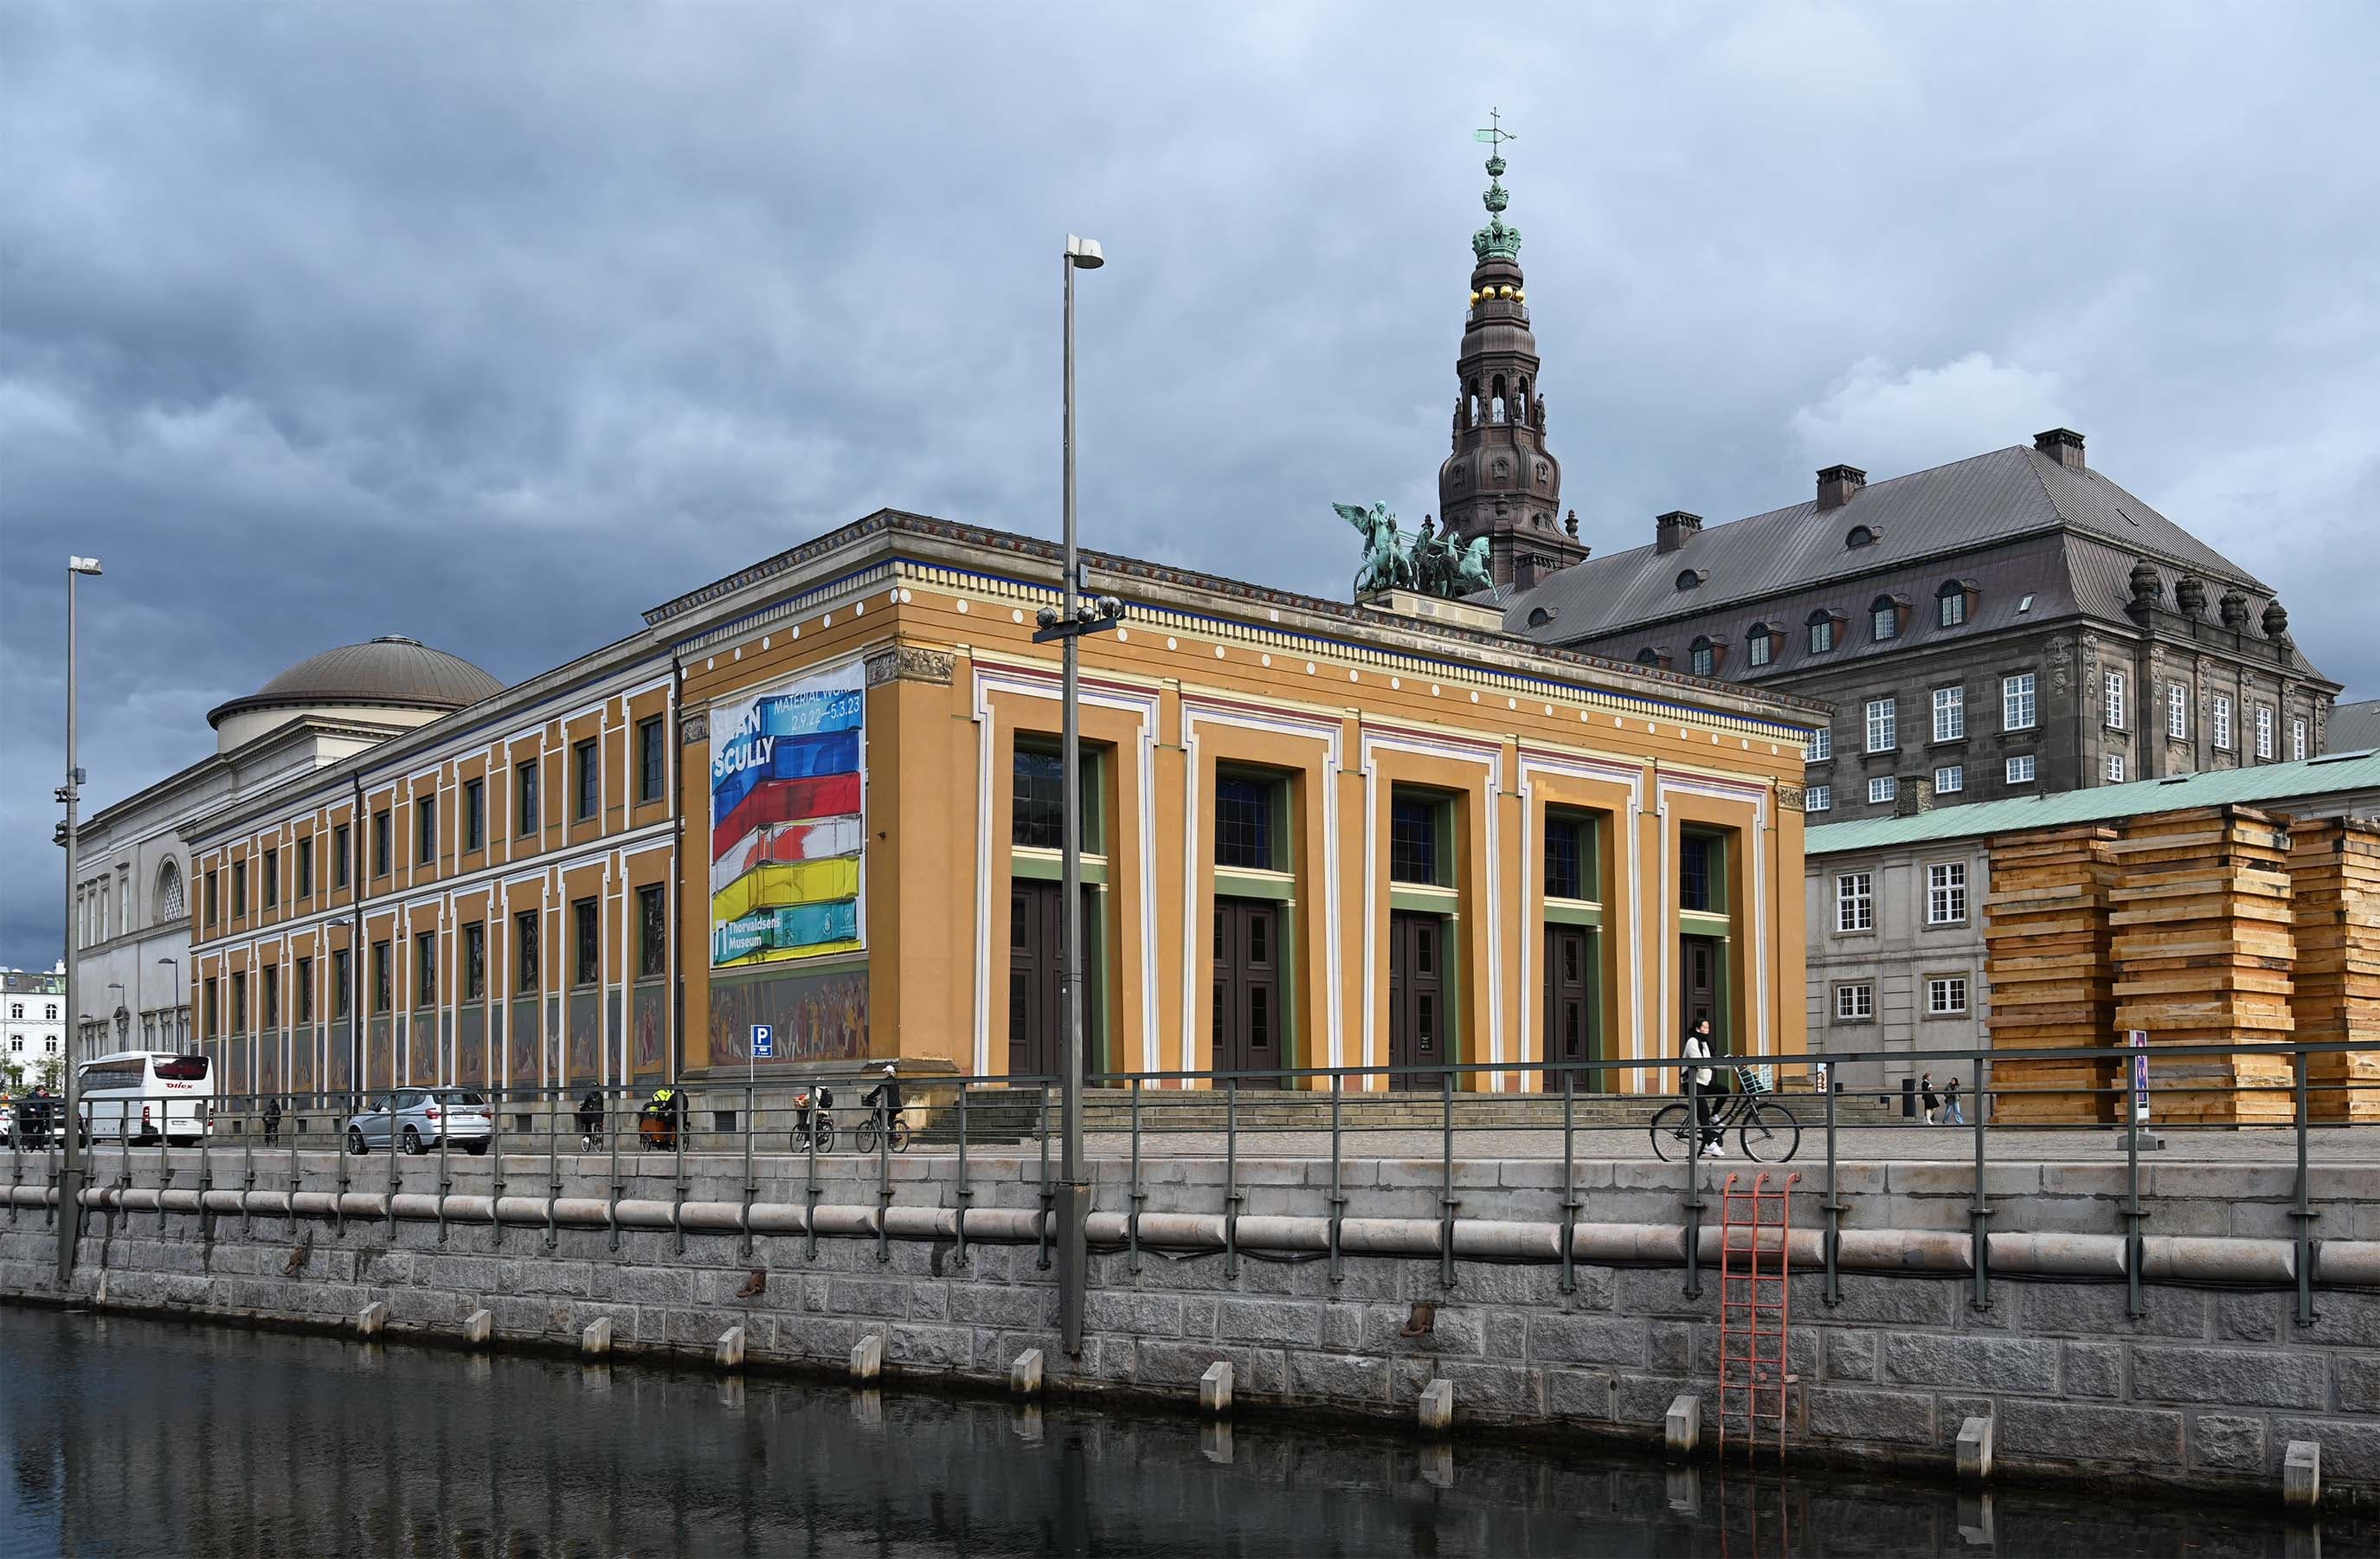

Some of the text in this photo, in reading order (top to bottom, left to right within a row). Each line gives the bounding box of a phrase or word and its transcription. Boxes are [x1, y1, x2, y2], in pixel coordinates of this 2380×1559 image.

[774, 692, 820, 716] MATERIAL
[714, 736, 775, 777] SCULLY
[729, 917, 781, 935] Thorvaldsens
[729, 936, 762, 950] Museum
[757, 1028, 769, 1044] P
